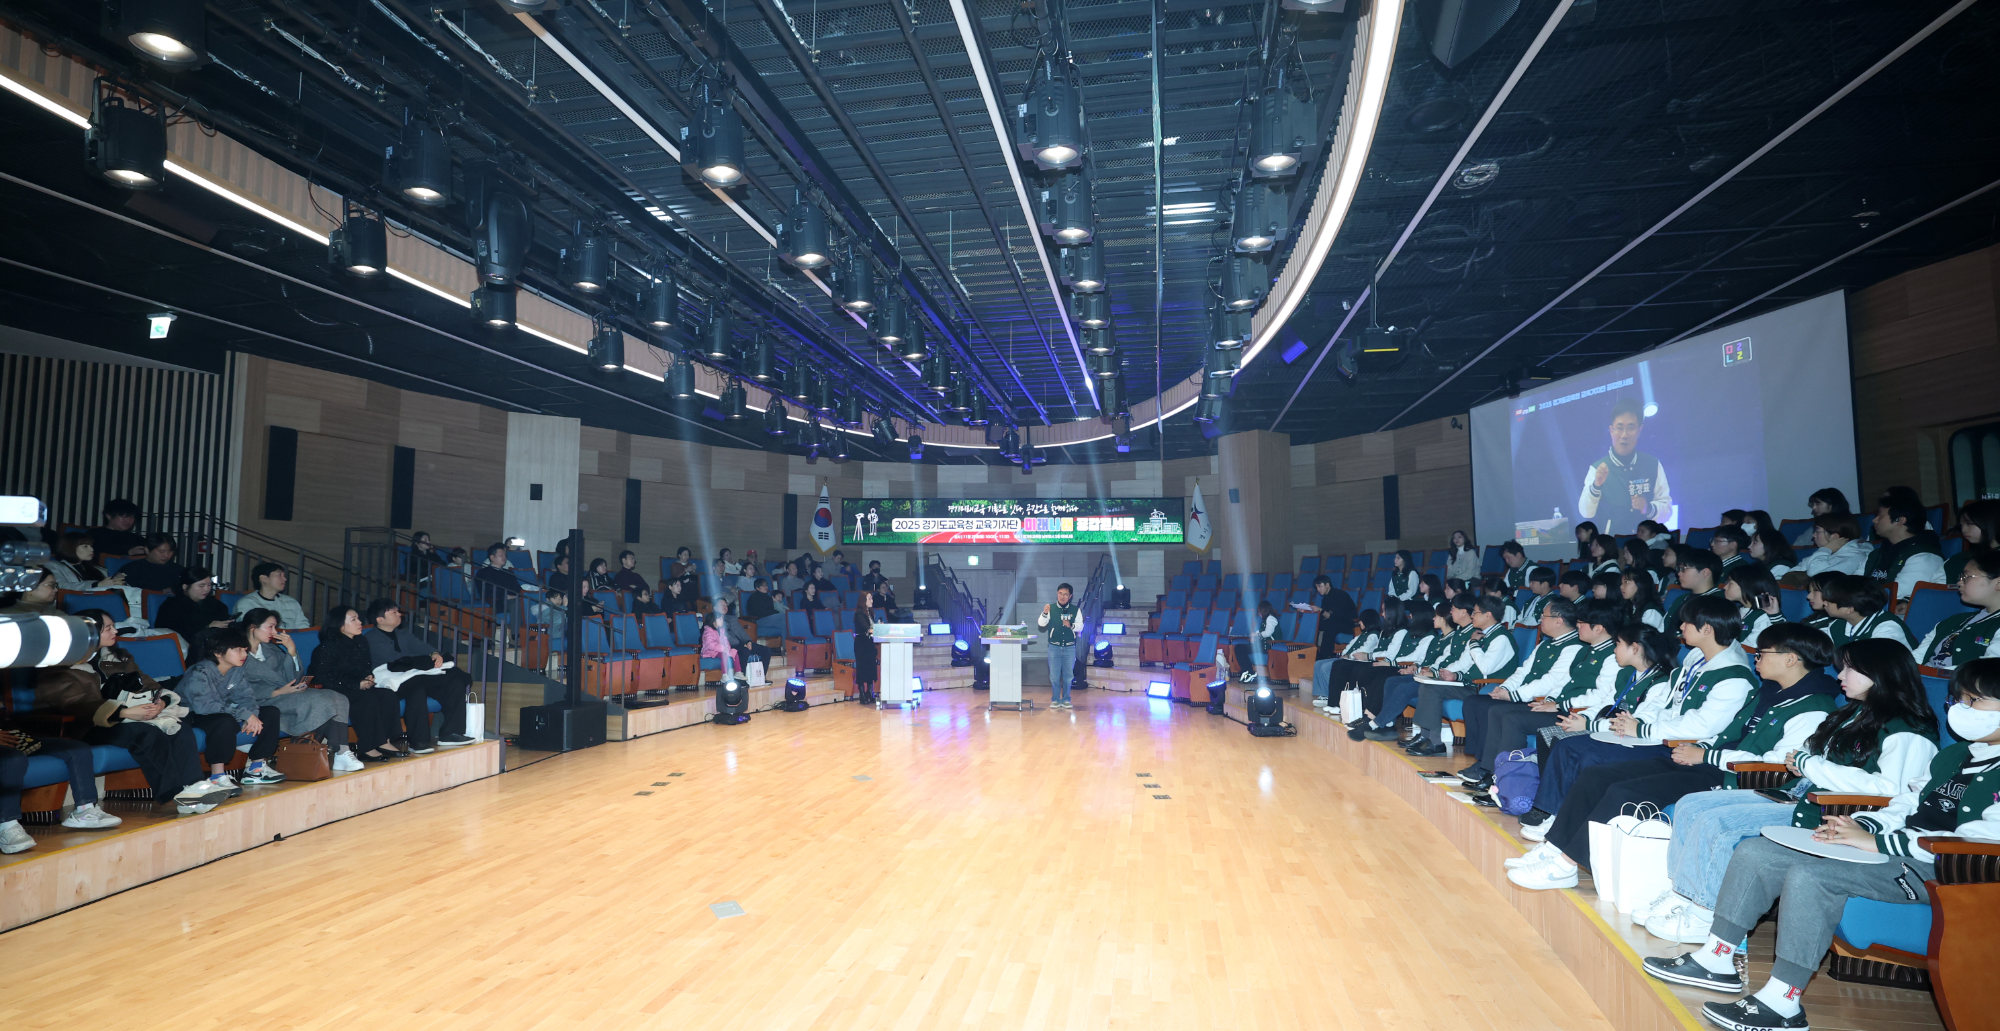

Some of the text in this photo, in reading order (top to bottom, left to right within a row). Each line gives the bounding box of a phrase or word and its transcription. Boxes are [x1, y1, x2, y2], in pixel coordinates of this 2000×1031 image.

[894, 520, 921, 530] 2025
[922, 520, 973, 531] 경기도교육청
[975, 520, 1019, 530] 교육기자단
[1023, 517, 1074, 532] 미래나래
[1711, 940, 1733, 958] P
